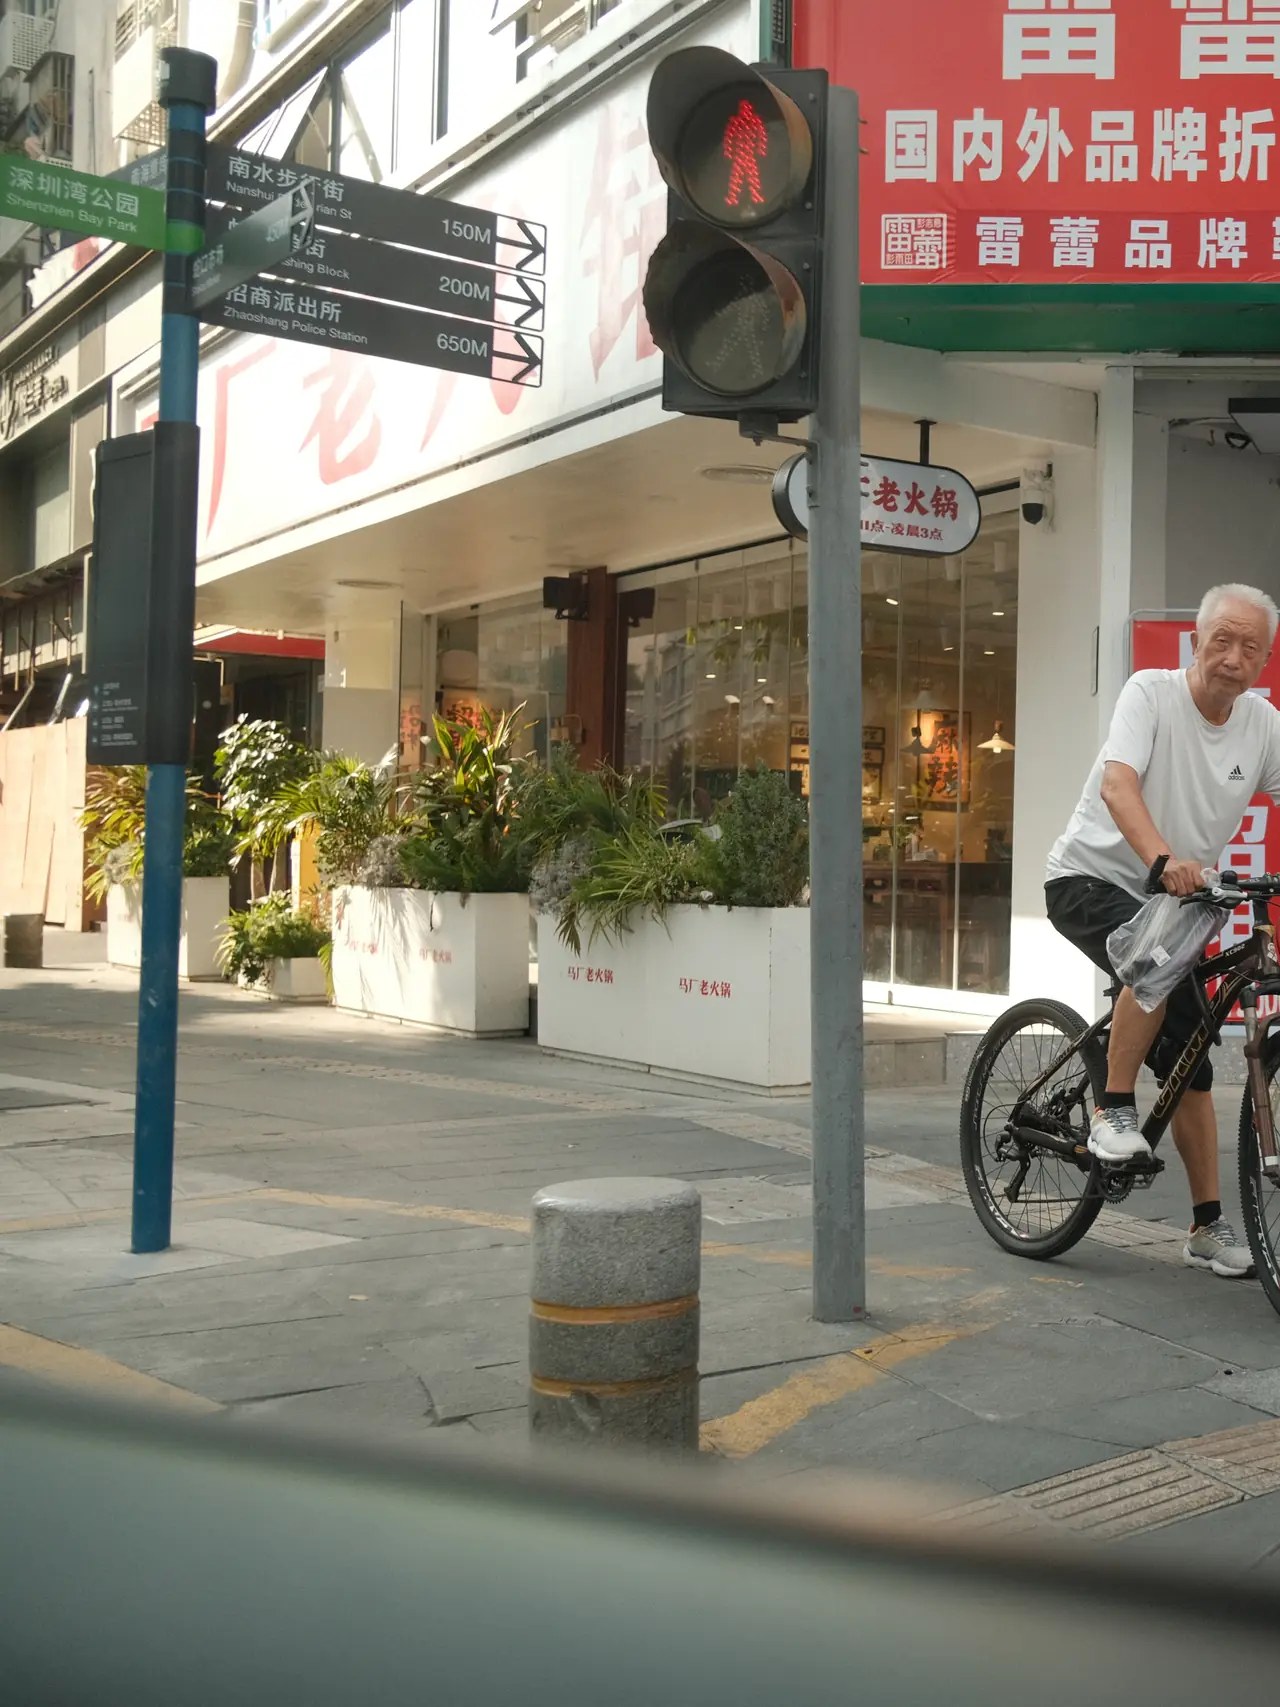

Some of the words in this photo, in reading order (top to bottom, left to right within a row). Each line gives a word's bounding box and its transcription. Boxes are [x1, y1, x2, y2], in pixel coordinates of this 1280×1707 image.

[9, 165, 139, 217] 深圳湾公园
[225, 180, 275, 201] Nanshui
[340, 207, 352, 220] St
[6, 192, 75, 218] Shenzhen
[78, 209, 104, 228] Bay
[108, 216, 138, 234] Park
[442, 219, 492, 245] 150M
[317, 263, 351, 280] Block
[225, 283, 343, 323] 招商派出所
[439, 275, 490, 302] 200M
[223, 305, 289, 331] Zhaoshang
[292, 320, 326, 337] Police
[328, 326, 368, 345] Station
[436, 333, 488, 358] 650M
[861, 475, 958, 521] 老火锅
[567, 965, 614, 984] 马厂老火锅
[679, 977, 731, 999] 马厂老火锅
